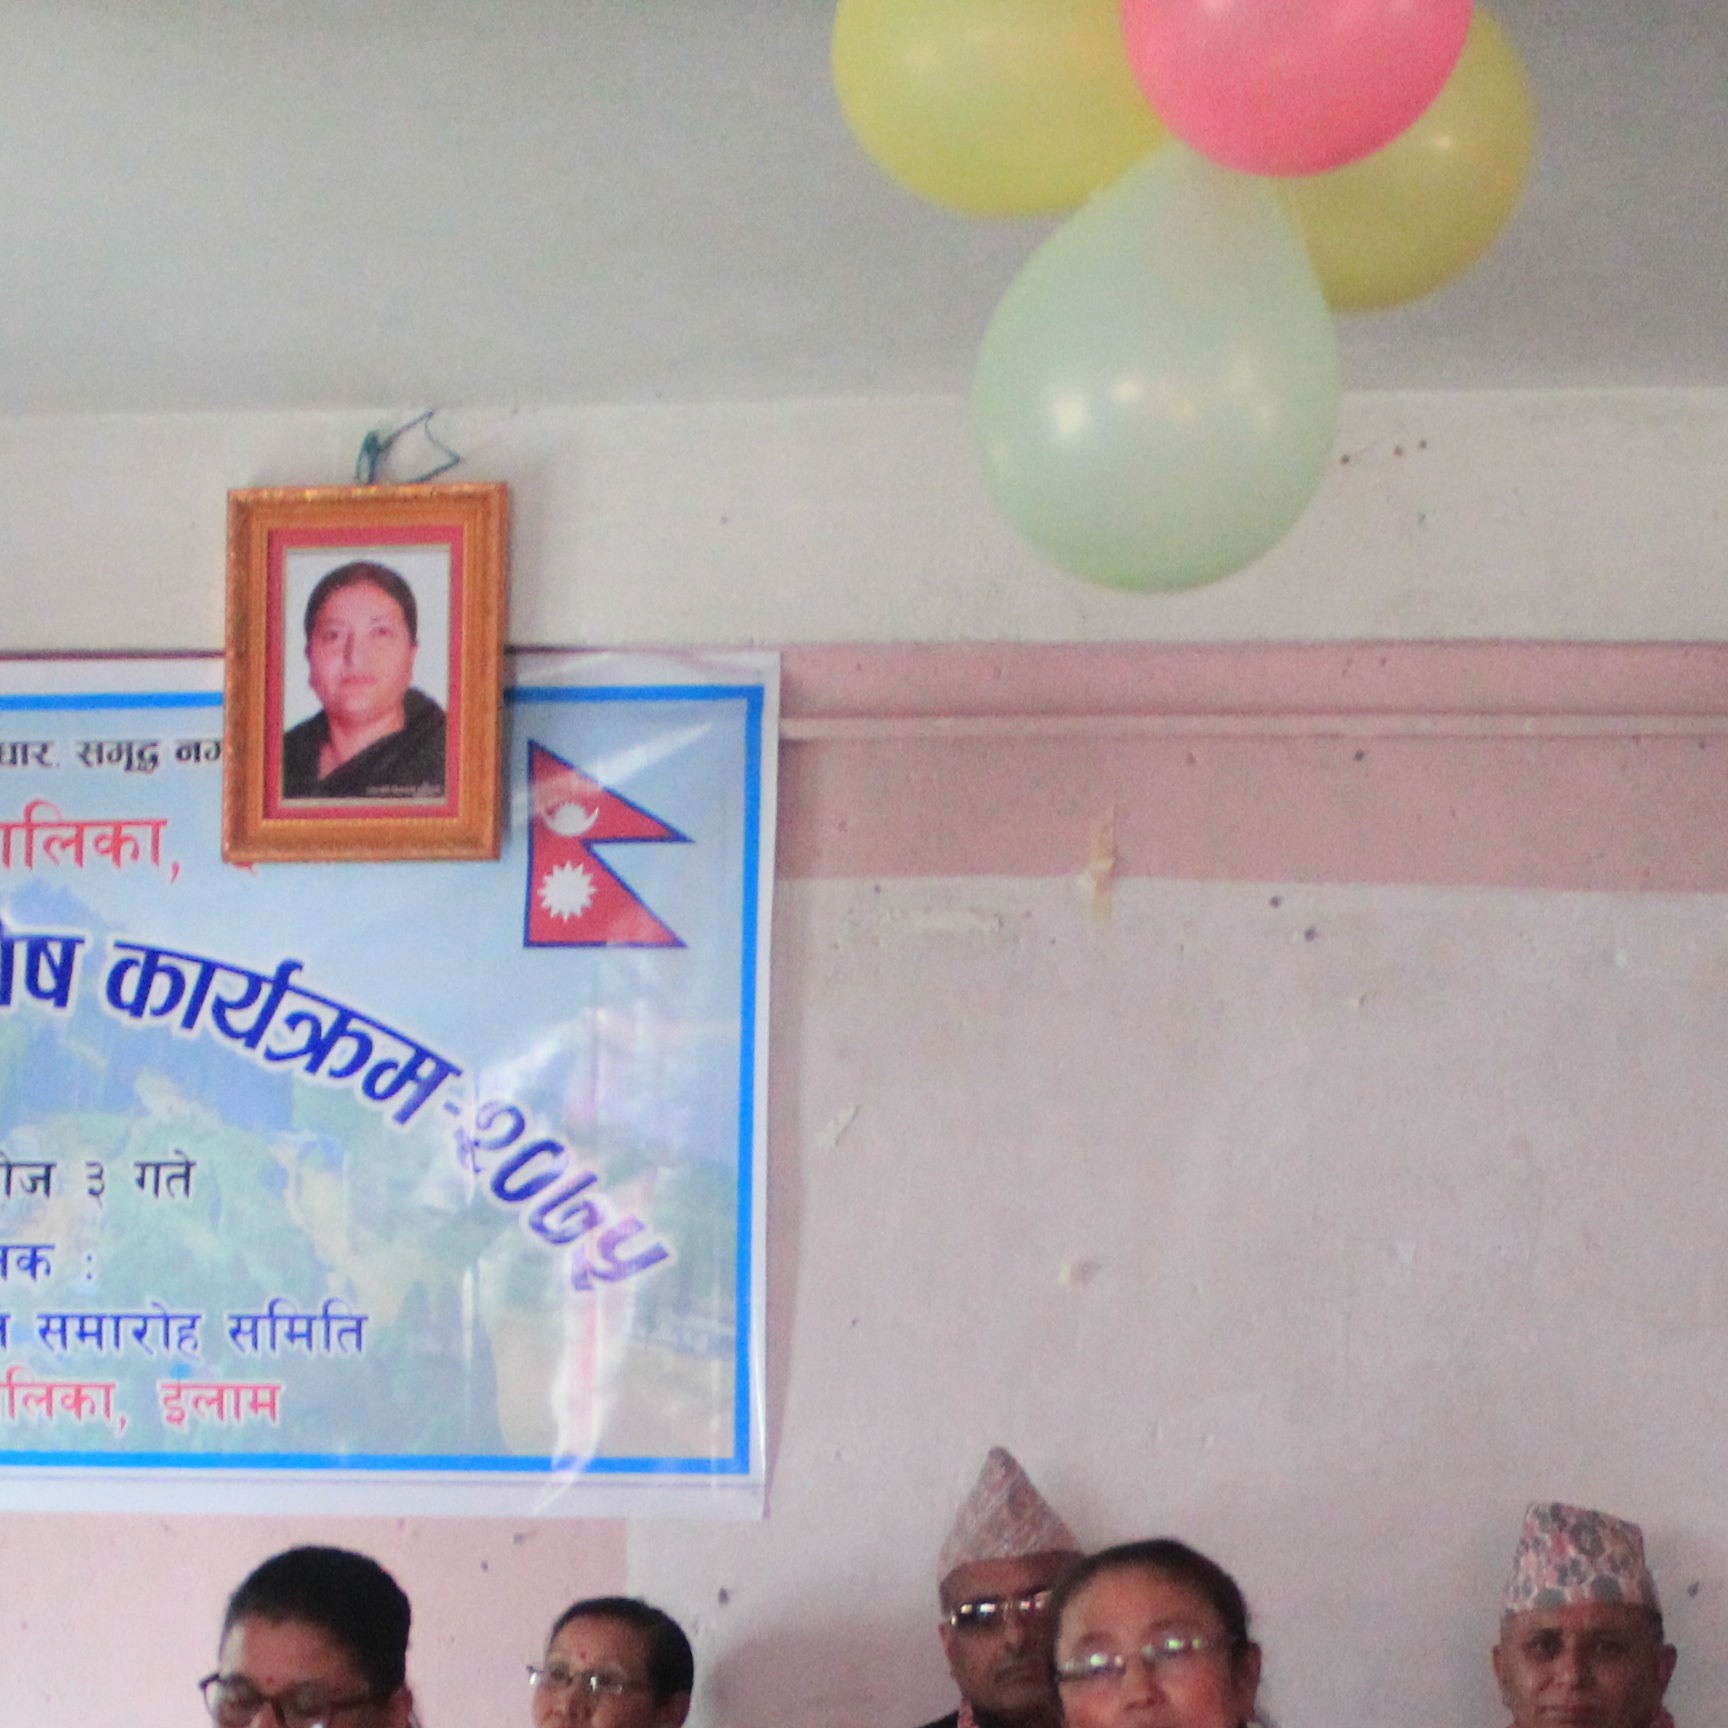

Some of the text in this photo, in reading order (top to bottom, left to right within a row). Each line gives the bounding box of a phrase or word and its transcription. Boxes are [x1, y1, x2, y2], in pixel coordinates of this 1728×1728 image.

[76, 739, 161, 775] समृद्ध
[86, 1161, 106, 1208] ३
[134, 1148, 196, 1199] गते
[37, 1301, 202, 1361] समारोह
[228, 1298, 369, 1352] समिति
[161, 1382, 284, 1427] इलाम
